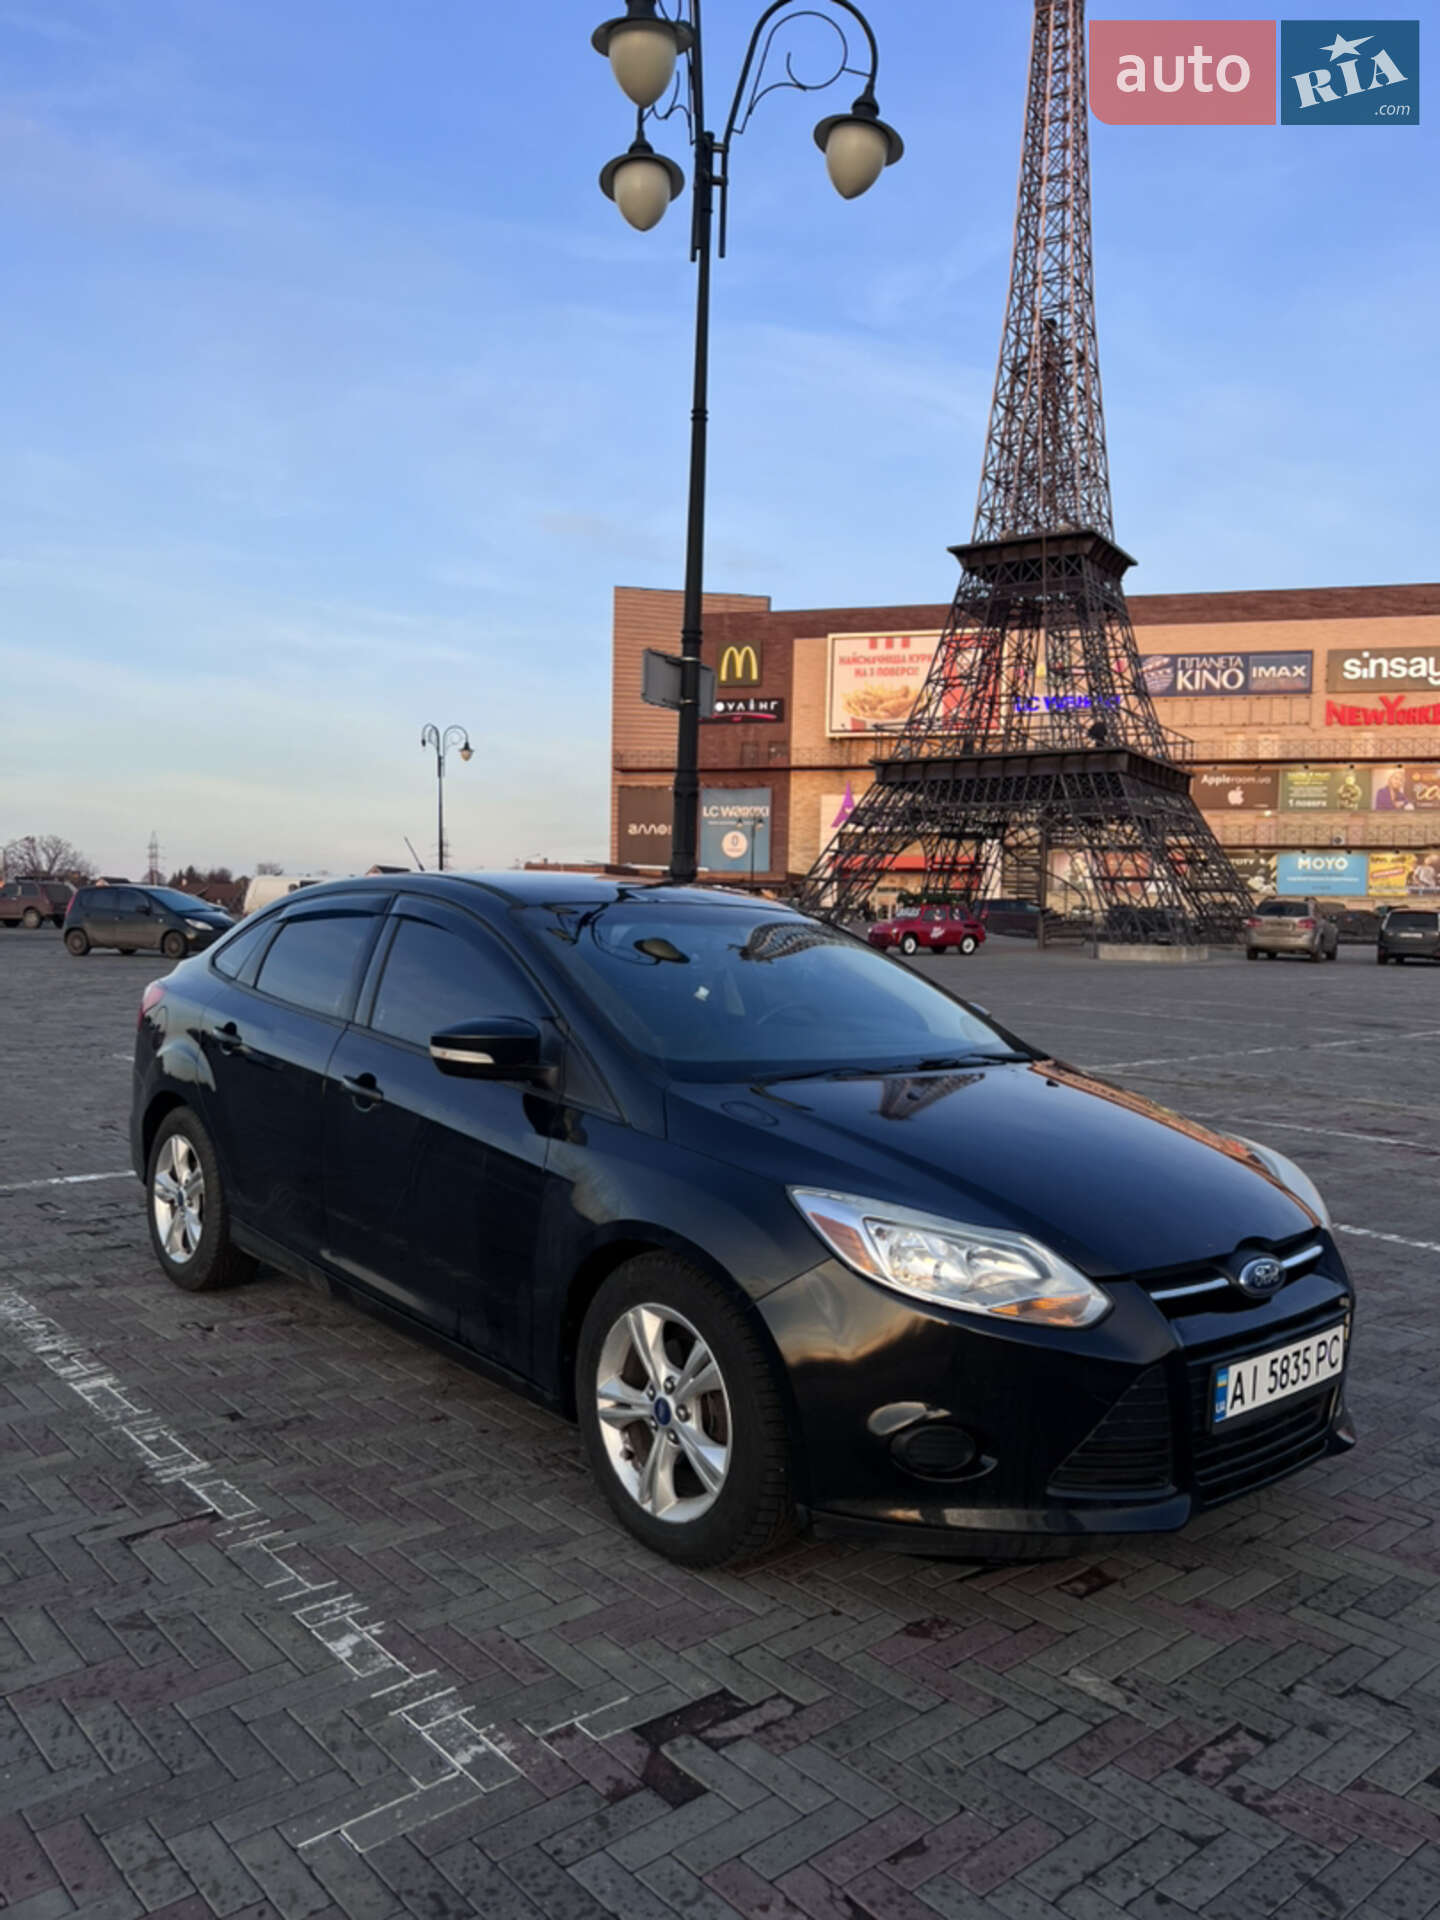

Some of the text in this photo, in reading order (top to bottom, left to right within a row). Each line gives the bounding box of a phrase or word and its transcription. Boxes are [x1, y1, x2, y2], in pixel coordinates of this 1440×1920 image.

[1176, 668, 1245, 691] KINO
[1252, 665, 1307, 678] IMAX
[1297, 856, 1349, 871] MOYO
[1267, 1346, 1312, 1395] 5835
[1315, 1335, 1340, 1377] PC
